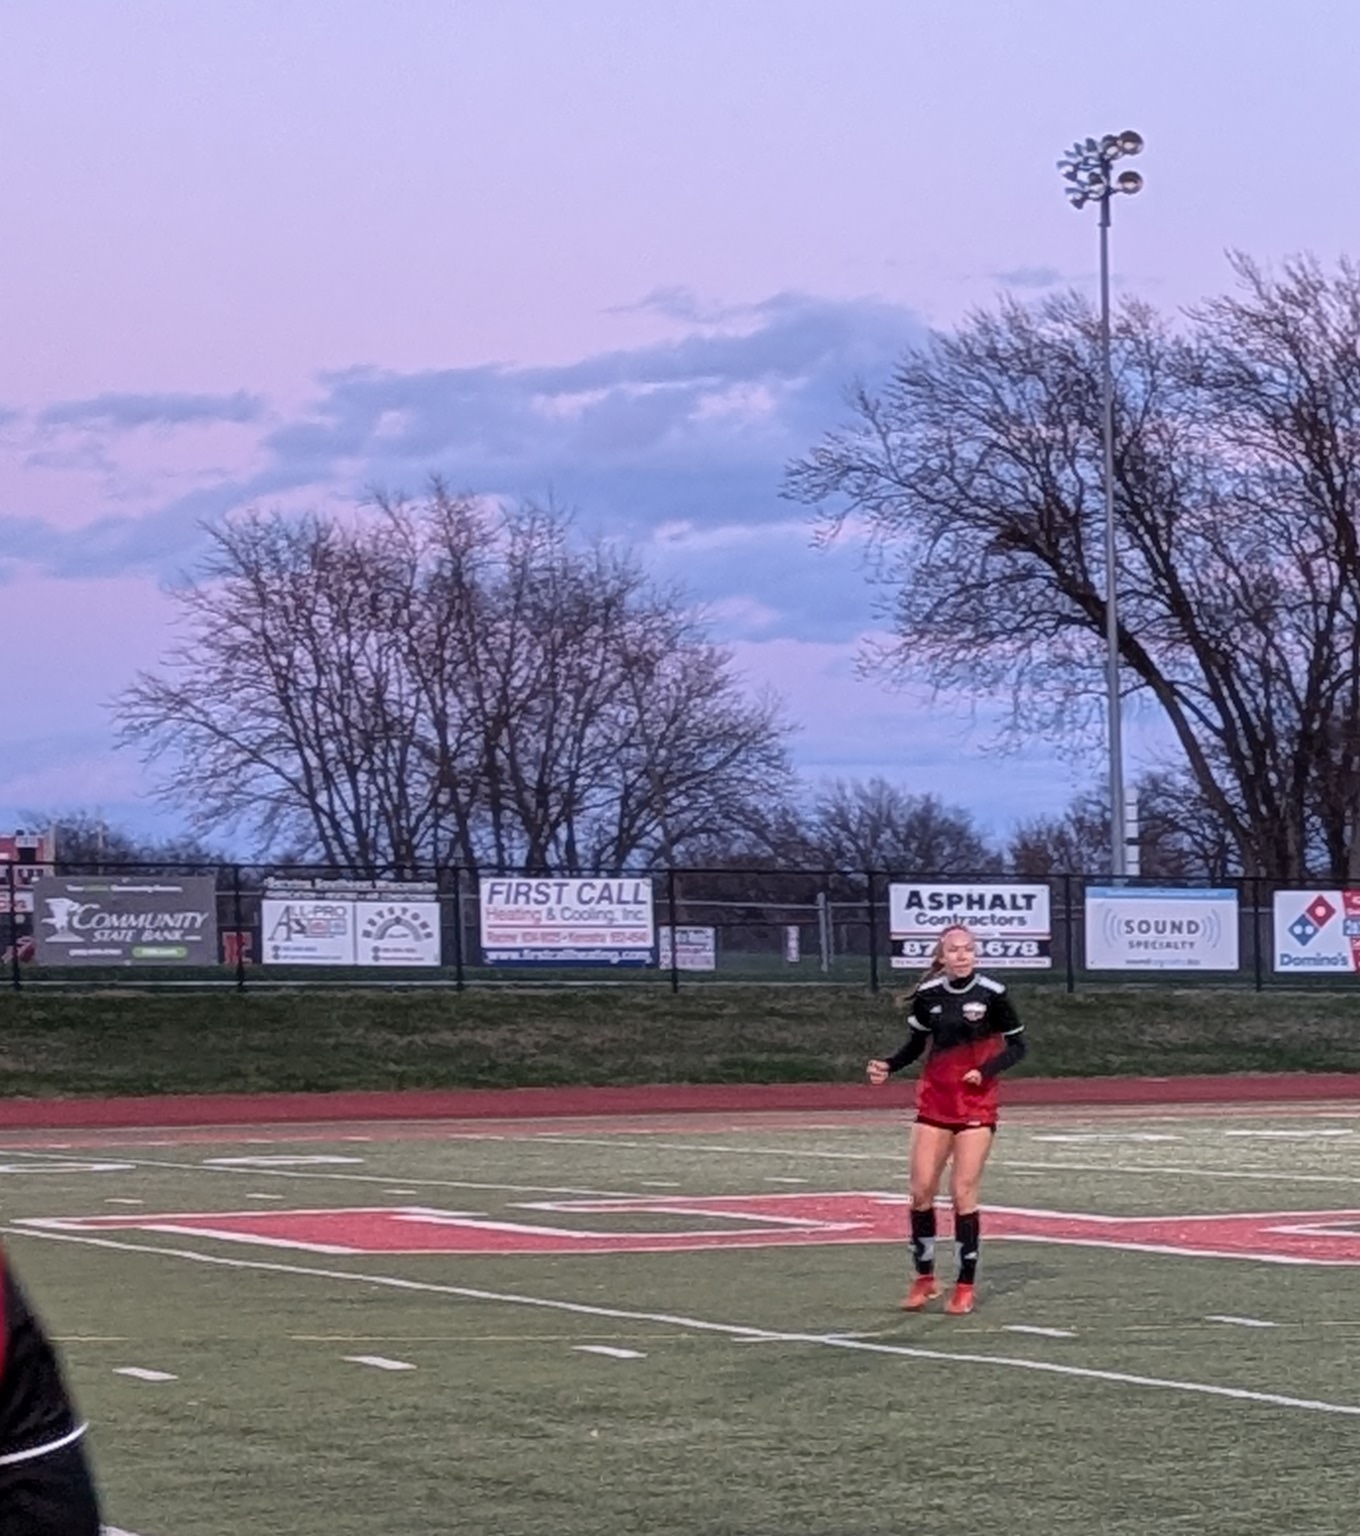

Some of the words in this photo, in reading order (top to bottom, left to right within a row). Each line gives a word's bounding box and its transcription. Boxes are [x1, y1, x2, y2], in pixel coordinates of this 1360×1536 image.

[487, 882, 569, 905] FIRST
[576, 882, 648, 905] CALL
[905, 890, 1037, 911] ASPHALT
[486, 908, 542, 924] Heating
[545, 908, 557, 921] &
[622, 908, 646, 921] Inc.
[914, 912, 1027, 926] Contractors
[1124, 920, 1200, 934] SOUND
[92, 929, 136, 942] STATE
[141, 929, 184, 942] BANK
[1128, 940, 1195, 950] SPECIALTY
[1280, 952, 1348, 966] Domino's
